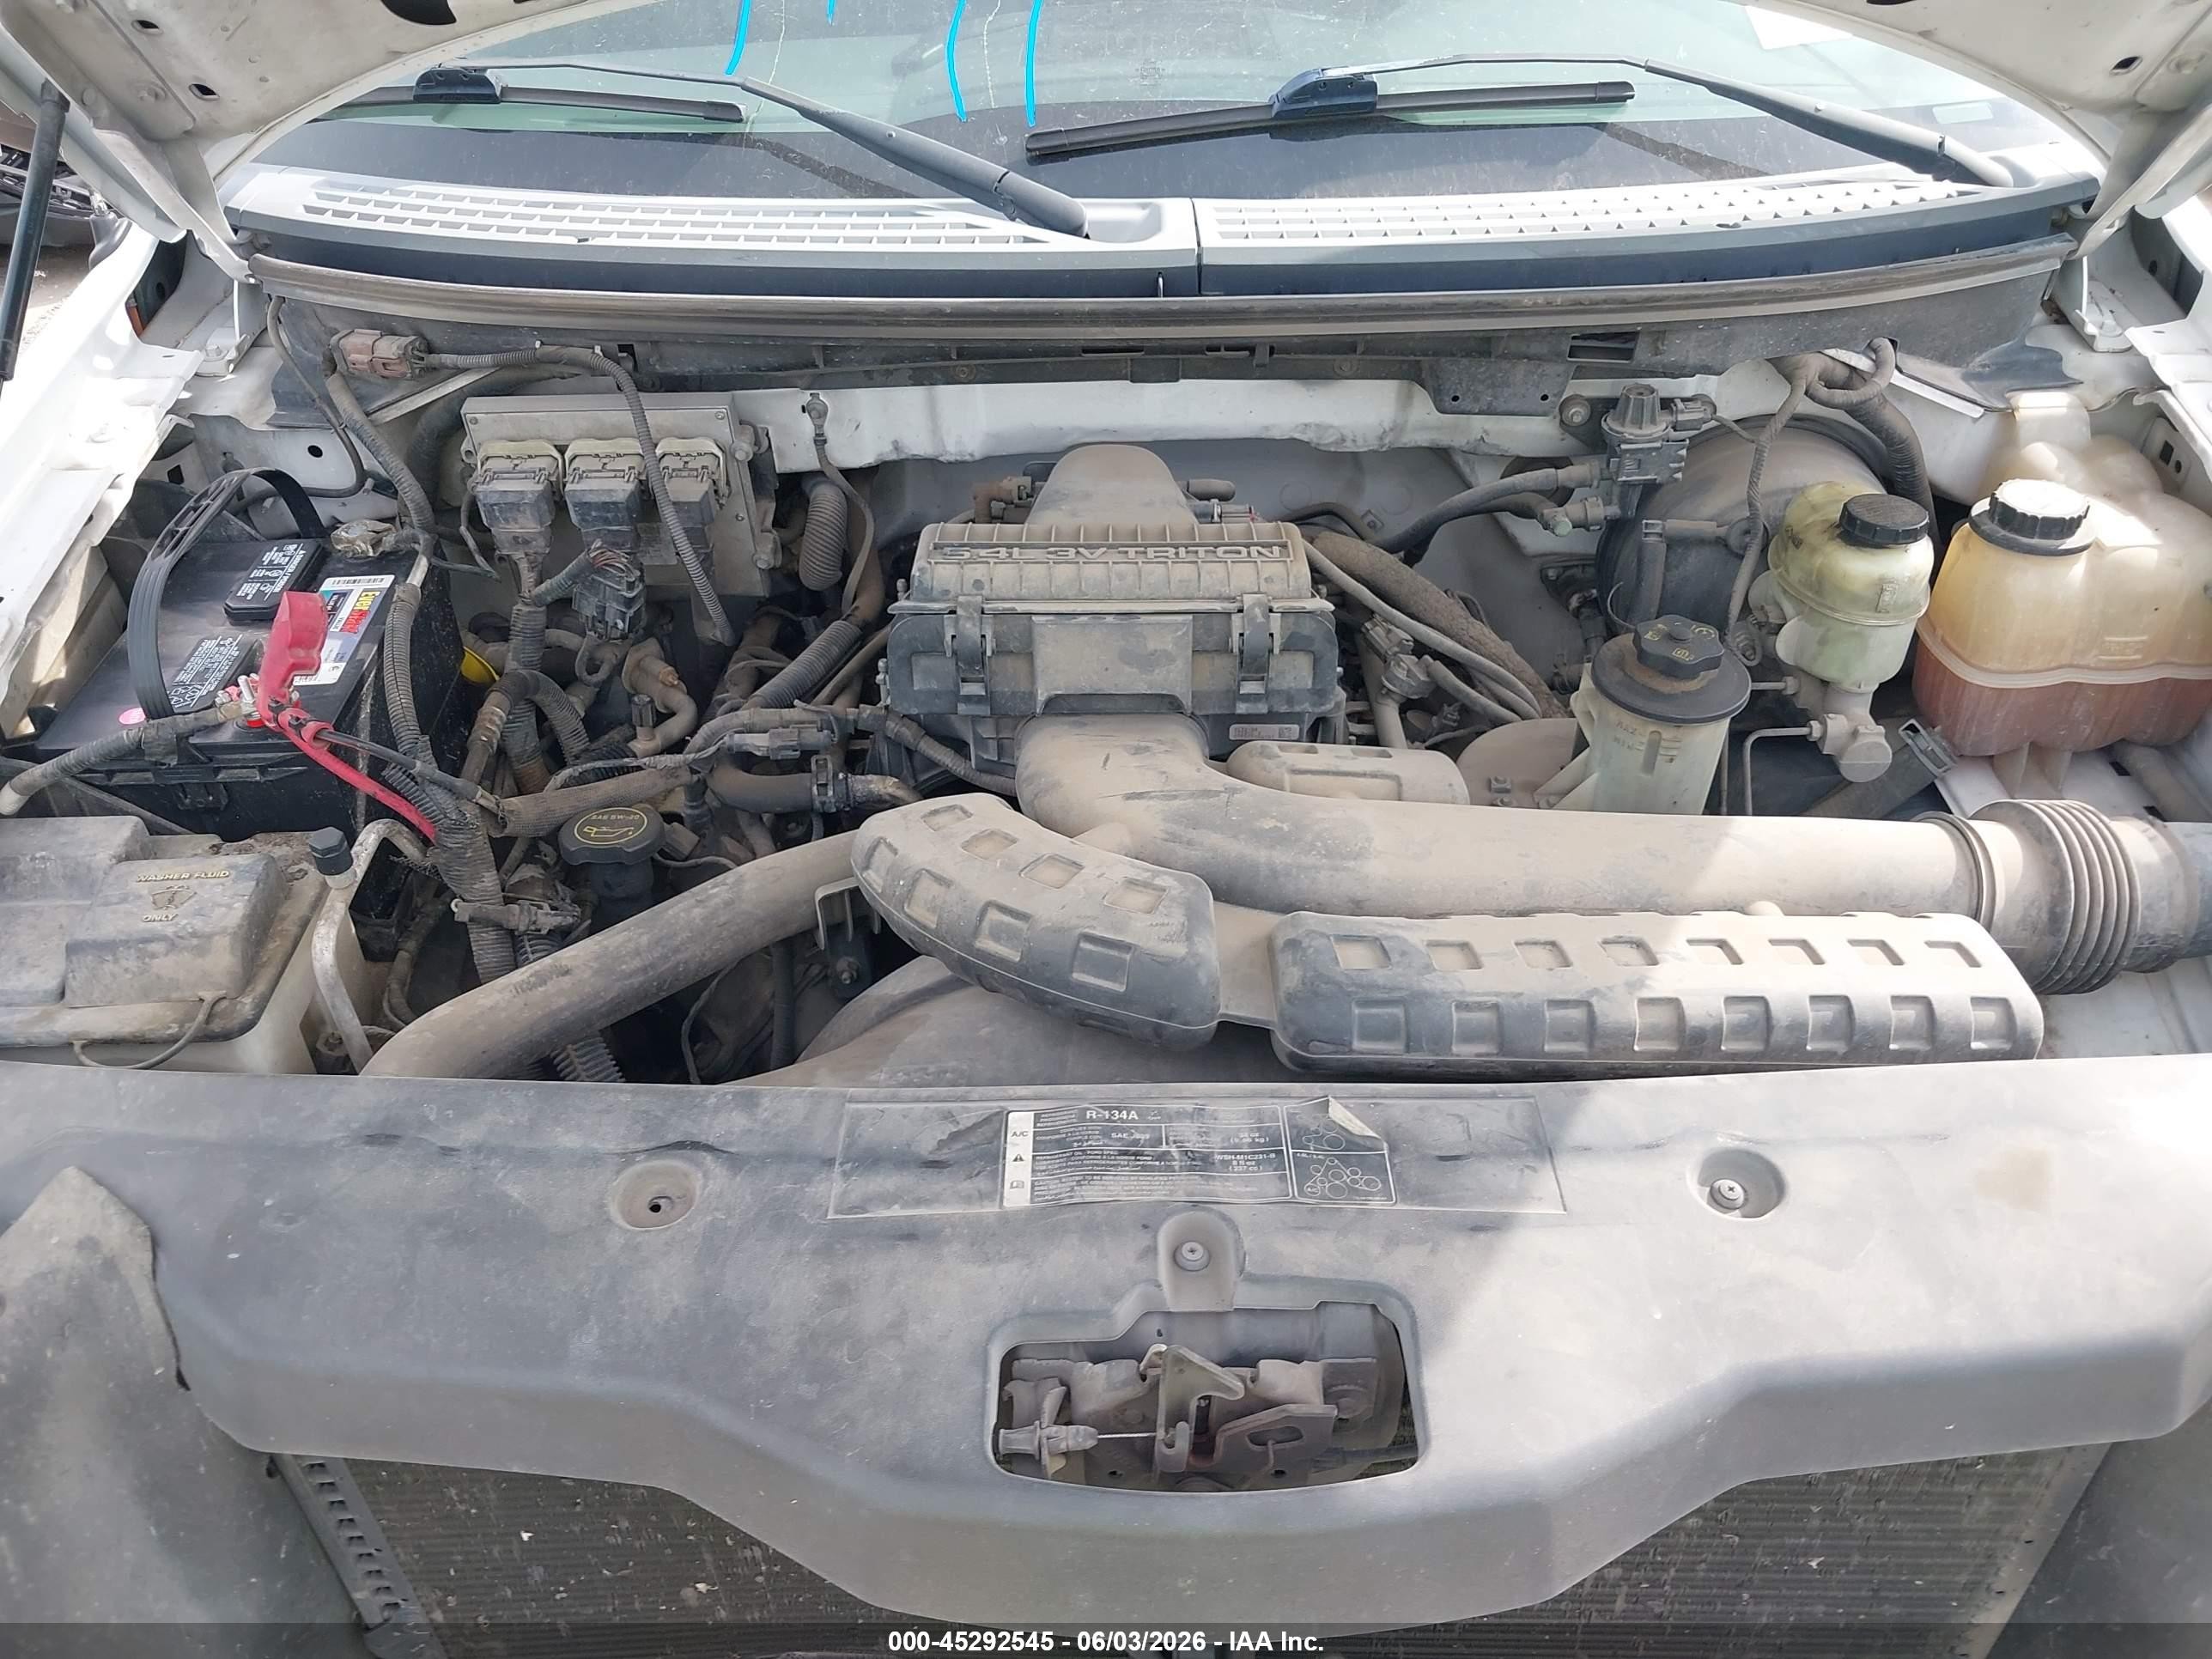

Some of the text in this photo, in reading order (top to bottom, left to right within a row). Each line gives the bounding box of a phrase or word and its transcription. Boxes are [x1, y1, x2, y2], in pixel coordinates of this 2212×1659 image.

[944, 546, 1280, 560] 5.4L 3V TRITON
[339, 591, 381, 634] EverStart
[137, 871, 230, 883] WASHER FLUID
[143, 914, 179, 922] ONLY
[1085, 1110, 1139, 1121] R-134A
